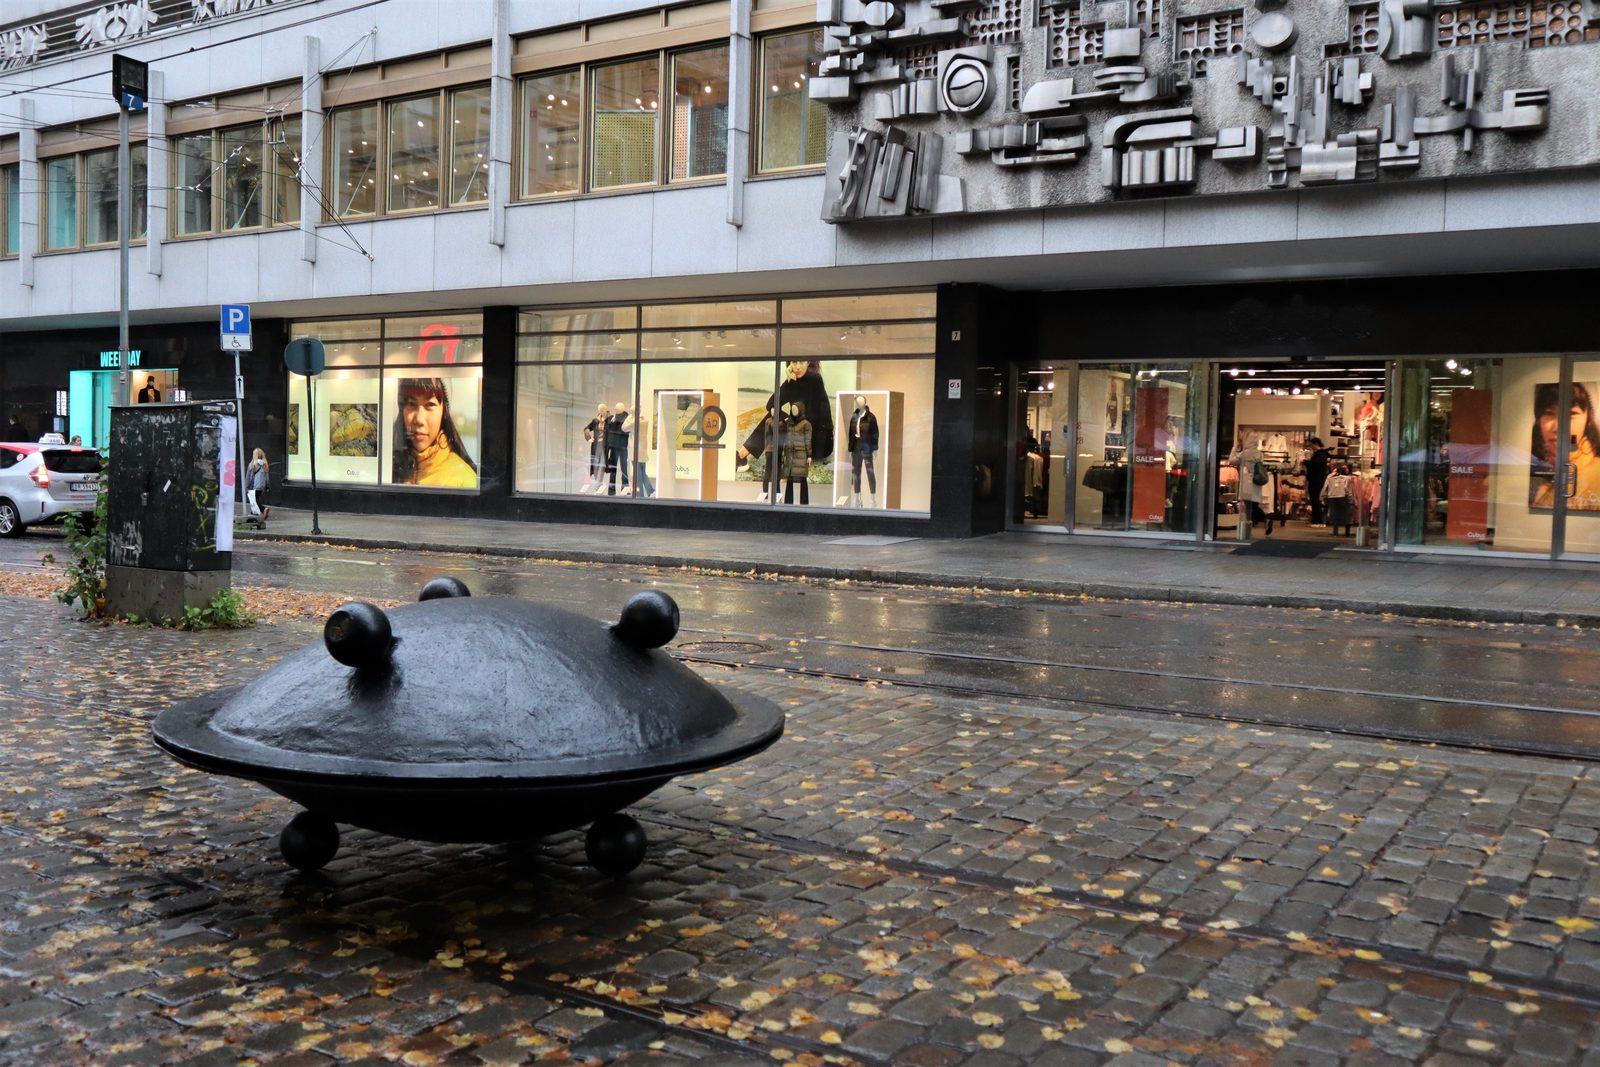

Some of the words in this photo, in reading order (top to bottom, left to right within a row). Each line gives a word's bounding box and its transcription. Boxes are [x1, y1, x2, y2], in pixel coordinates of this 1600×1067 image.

[127, 93, 135, 107] 7
[229, 308, 244, 331] P
[100, 350, 141, 367] WEEAY
[683, 405, 727, 442] 40
[1136, 455, 1154, 463] SALE
[1451, 466, 1474, 474] SALE
